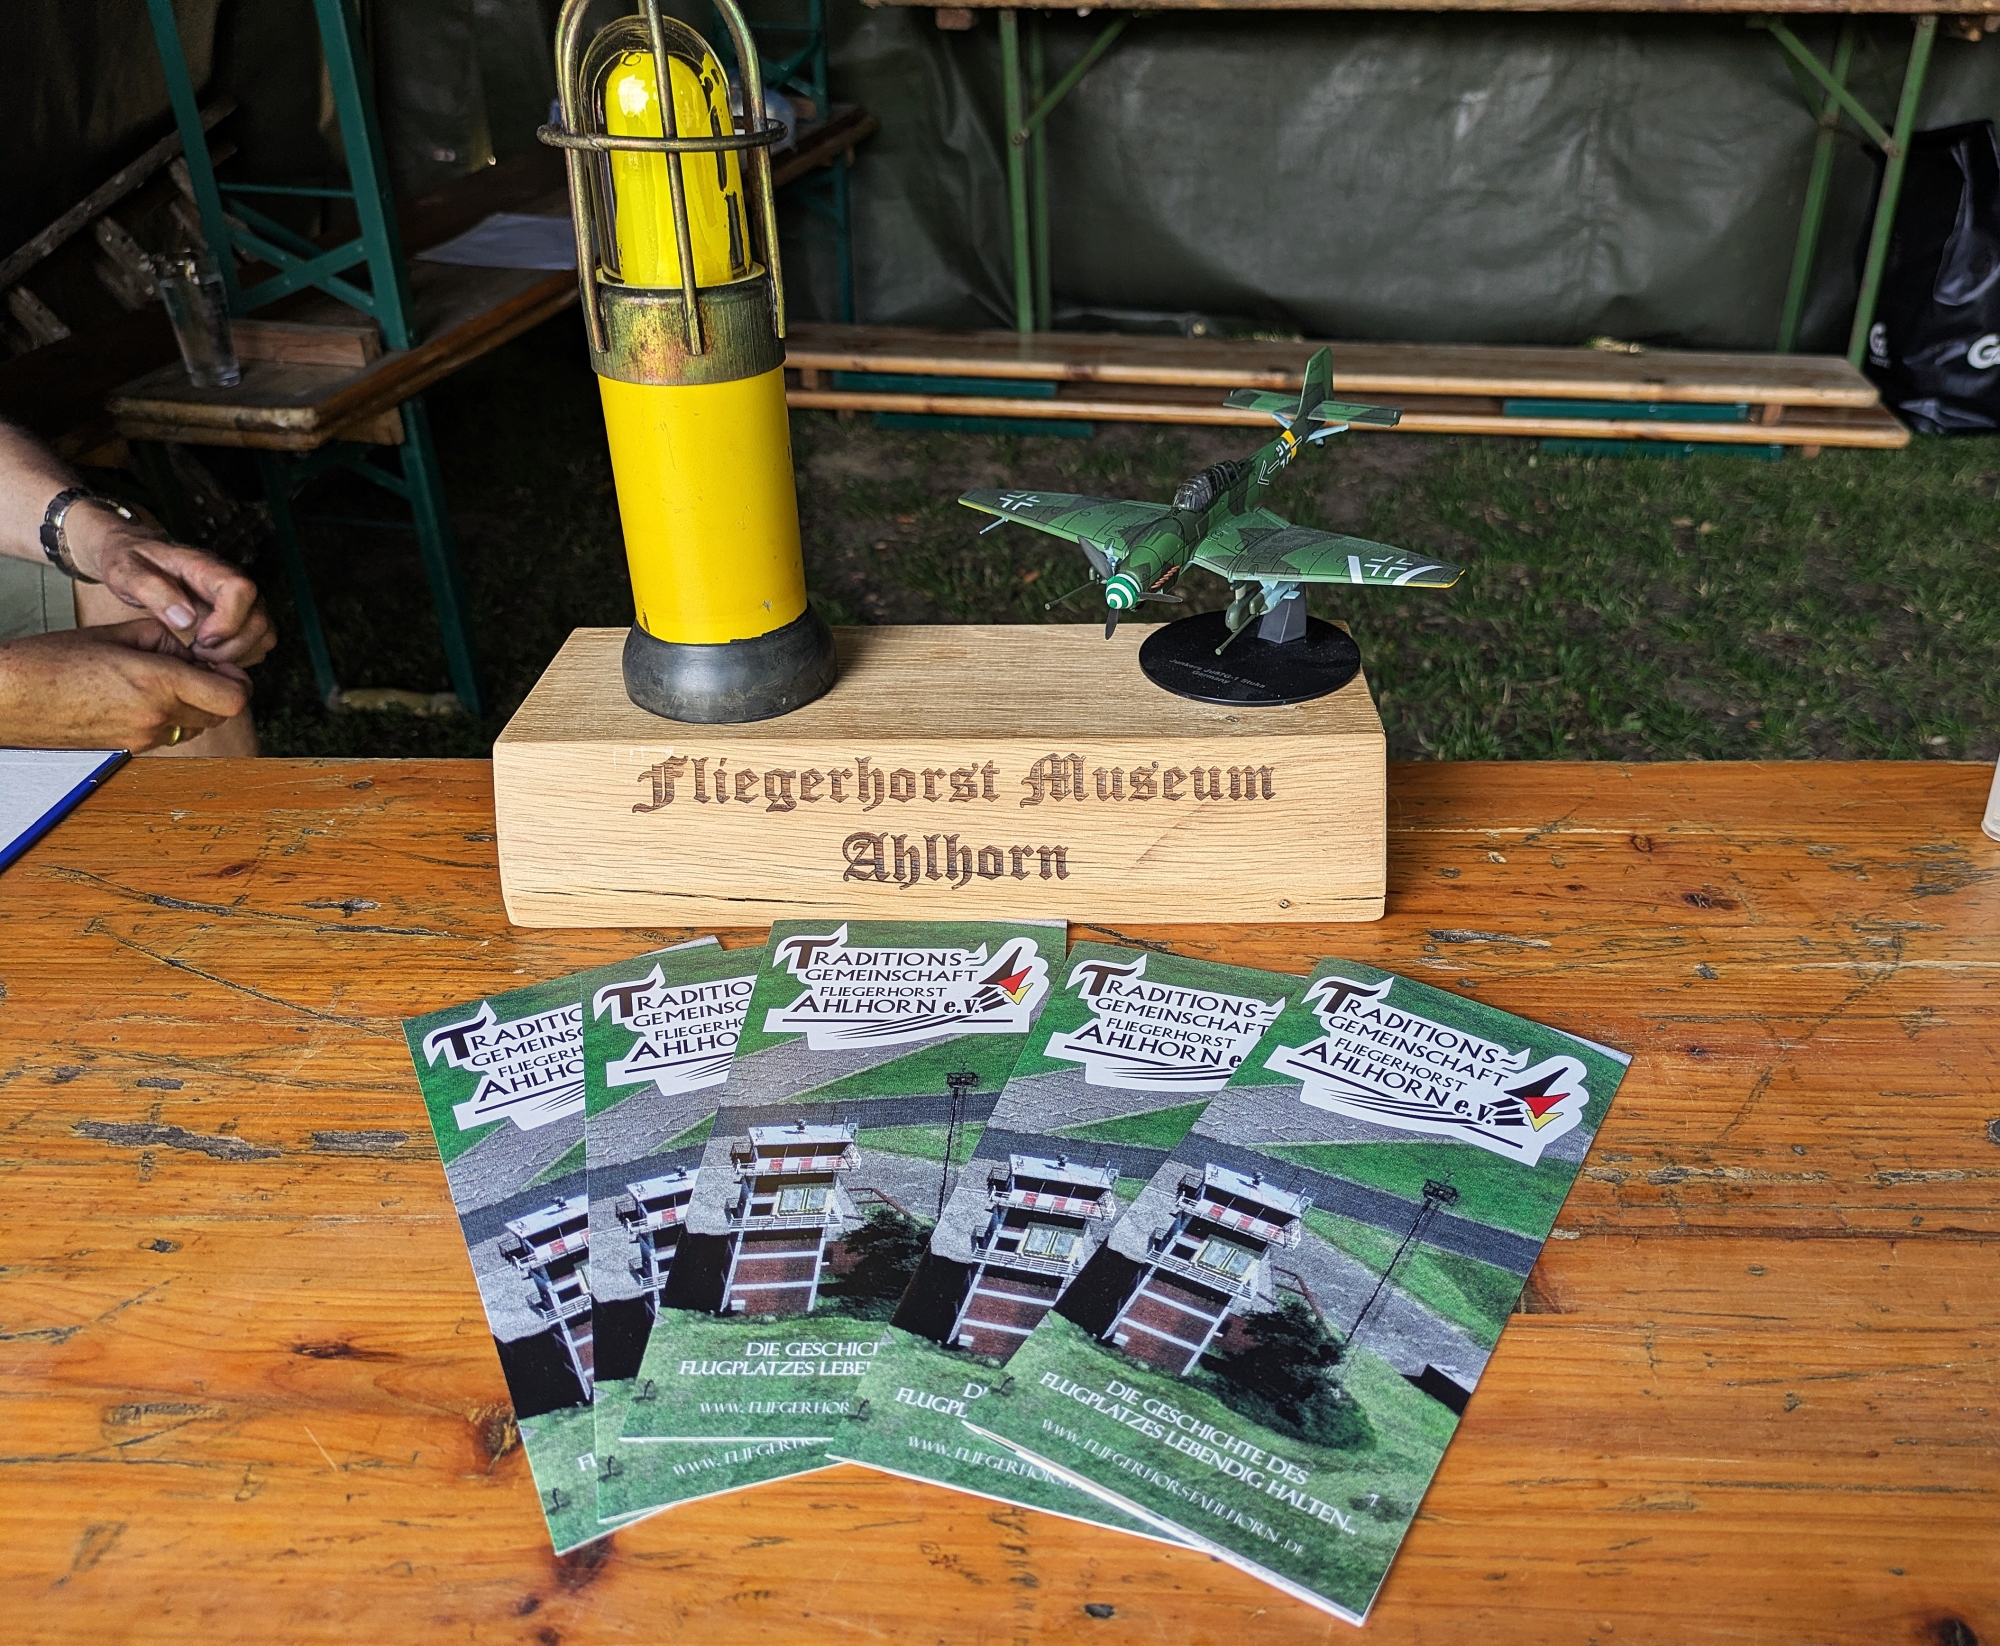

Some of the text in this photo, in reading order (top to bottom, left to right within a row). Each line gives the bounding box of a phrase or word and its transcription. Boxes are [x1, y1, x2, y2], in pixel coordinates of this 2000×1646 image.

[1169, 659, 1203, 671] Junkers
[1240, 678, 1266, 689] Stuka
[1191, 670, 1231, 684] Germany
[631, 752, 1277, 814] Fliegerhorst Museum
[842, 831, 1071, 891] Ahlhorn
[804, 968, 979, 982] GEMEINSCHAFT
[819, 986, 948, 998] FLIEGERHORST
[601, 977, 753, 1019] TRADITIO
[790, 994, 981, 1014] AHLHORN e.V.
[1095, 997, 1270, 1037] GEMEINSCHAFT
[1105, 1018, 1237, 1049] FLIEGERHORST
[630, 1031, 739, 1063] AHLHO
[1074, 1023, 1223, 1066] AHLHORN
[1328, 1015, 1509, 1087] GEMEINSCHAFT
[1298, 1041, 1495, 1125] AHLHORN e.V.
[1334, 1037, 1468, 1093] FLIEGERHORST
[745, 1341, 781, 1357] DIE
[678, 1360, 871, 1376] FLUGPLATZES LEBE
[894, 1386, 968, 1419] FLUGPL
[1039, 1371, 1166, 1440] FLUGPLATZES
[1163, 1432, 1267, 1489] LEBENDIG
[1104, 1379, 1311, 1486] DIE GESCHICHTE DES
